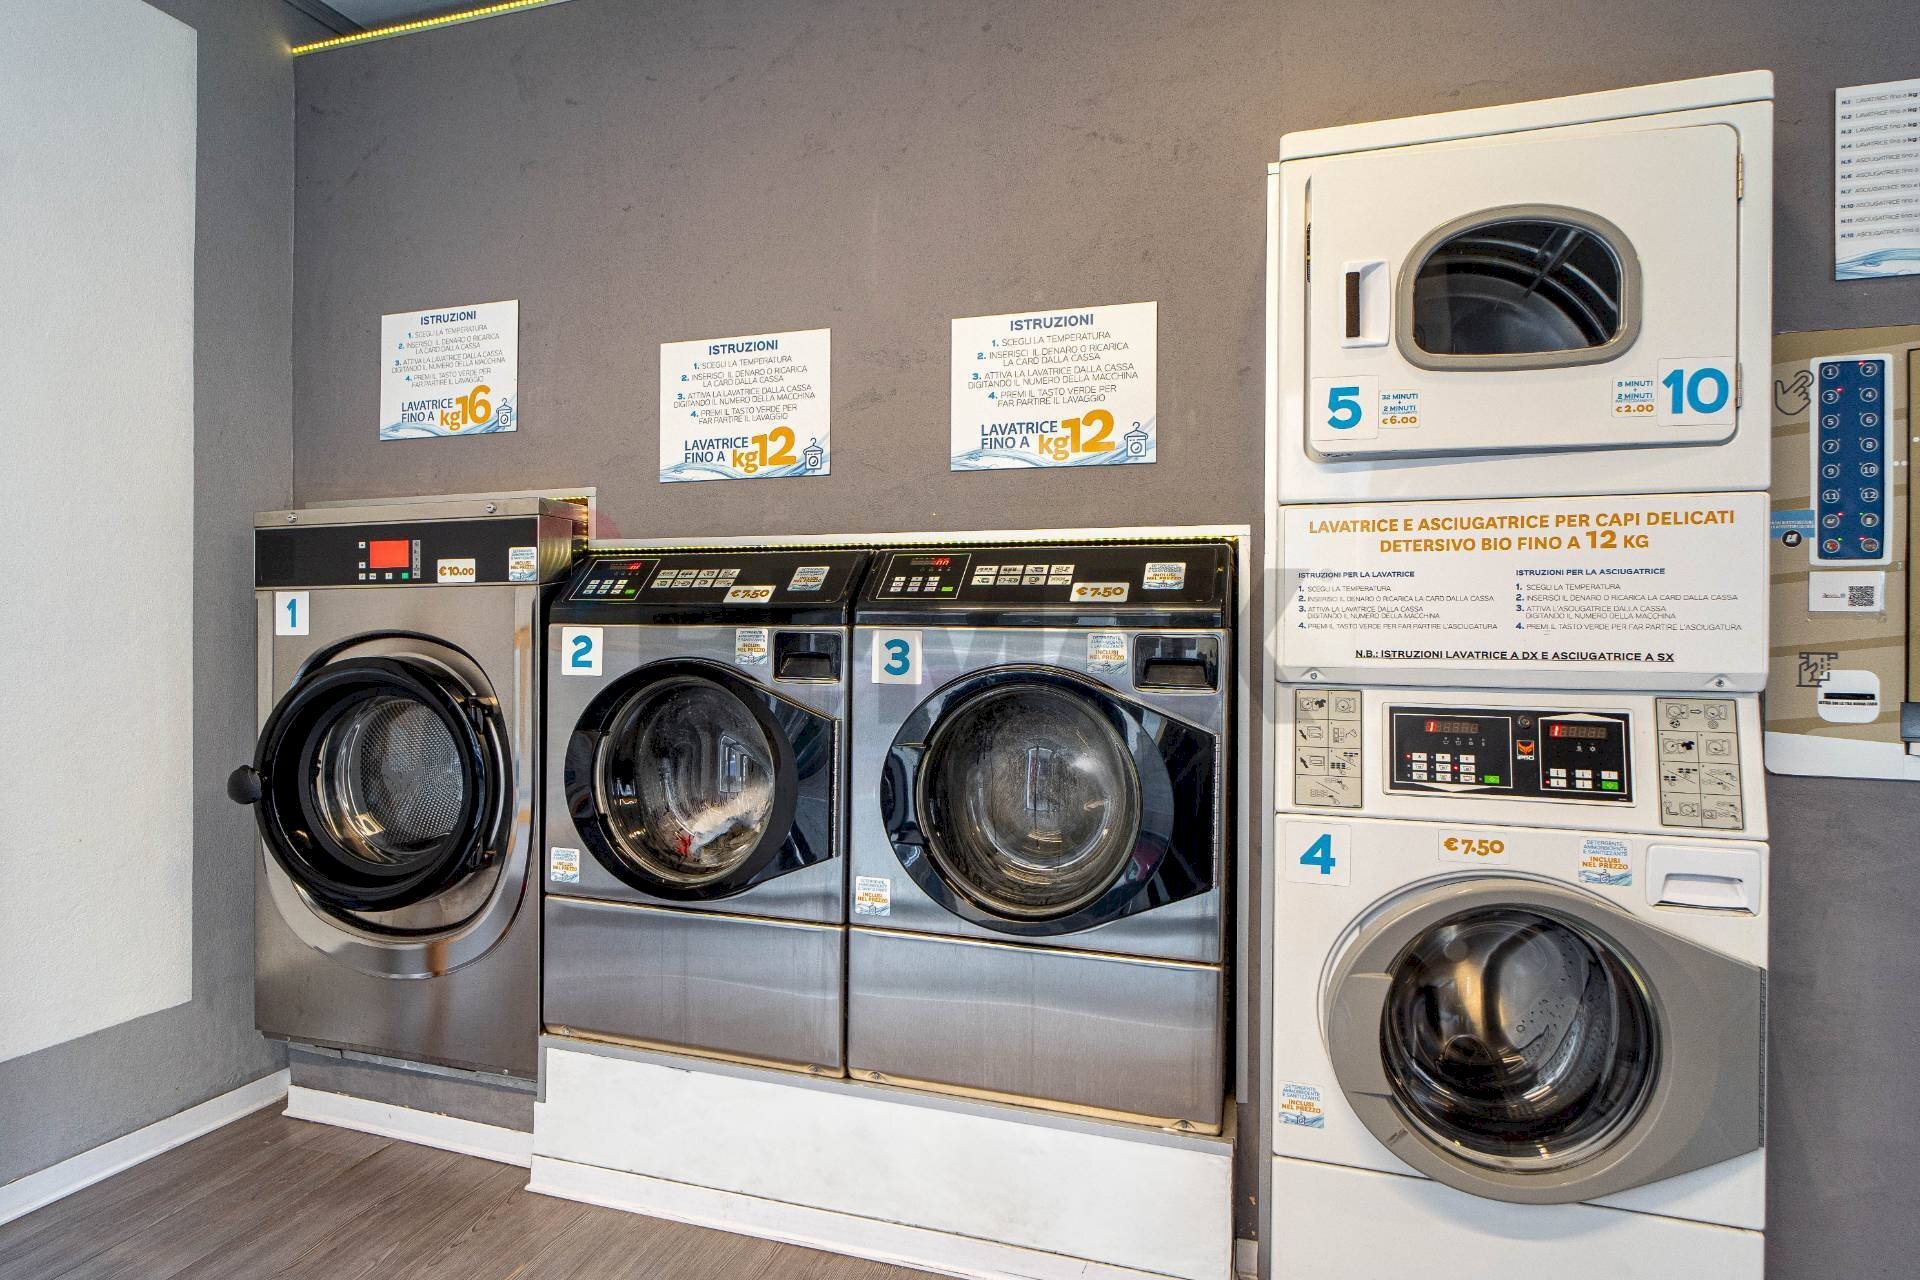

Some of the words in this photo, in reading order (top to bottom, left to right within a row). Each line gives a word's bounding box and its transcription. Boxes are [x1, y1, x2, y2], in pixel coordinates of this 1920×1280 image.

[420, 311, 476, 325] ISTRUZIONI
[1010, 314, 1094, 332] ISTRUZIONI
[1002, 338, 1032, 346] SCEGLI
[1034, 336, 1044, 344] LA
[1046, 331, 1110, 342] TEMPERATURA
[708, 340, 778, 356] ISTRUZIONI
[990, 350, 1028, 359] INSERISCI
[1032, 348, 1040, 356] IL
[1042, 346, 1078, 356] DENARO
[1080, 344, 1086, 353] O
[1090, 342, 1128, 352] RICARICA
[702, 360, 726, 370] SCEGLI
[728, 360, 738, 368] LA
[740, 355, 792, 366] TEMPERATURA
[1016, 356, 1040, 366] CARD
[1042, 355, 1069, 364] DALLA
[1070, 352, 1100, 362] CASSA
[692, 371, 725, 380] INSERISCI
[736, 368, 766, 378] DENARO
[774, 365, 808, 374] RICARICA
[972, 372, 982, 380] 3.
[984, 371, 1012, 380] ATTIVA
[1014, 370, 1026, 378] LA
[1028, 366, 1072, 376] LAVATRICE
[1074, 364, 1102, 374] DALLA
[1104, 362, 1134, 372] CASSA
[714, 378, 734, 387] CARD
[734, 376, 758, 385] DALLA
[760, 374, 784, 383] CASSA
[968, 380, 1012, 390] DIGITANDO
[1014, 378, 1020, 386] IL
[1022, 376, 1060, 386] NUMERO
[1062, 374, 1090, 384] DELLA
[1092, 371, 1138, 381] MACCHINA
[688, 391, 711, 400] ATTIVA
[723, 387, 760, 397] LAVATRICE
[762, 386, 786, 394] DALLA
[786, 384, 812, 392] CASSA
[988, 392, 998, 400] 4.
[1000, 390, 1026, 398] PREMI
[1028, 390, 1036, 398] IL
[1038, 388, 1065, 396] TASTO
[1067, 386, 1096, 394] VERDE
[1098, 384, 1117, 392] PER
[1662, 368, 1730, 414] 10
[402, 398, 452, 412] LAVATRICE
[998, 400, 1014, 408] FAR
[1016, 396, 1052, 406] PARTIRE
[1054, 396, 1060, 404] IL
[1062, 394, 1106, 404] LAVAGGIO
[1327, 386, 1362, 429] 5
[402, 412, 425, 423] FINO
[428, 411, 434, 422] A
[981, 420, 1058, 436] LAVATRICE
[684, 436, 748, 451] LAVATRICE
[982, 436, 1016, 450] FINO
[1020, 436, 1030, 448] A
[684, 452, 714, 464] FINO
[716, 451, 725, 462] A
[1309, 519, 1398, 534] LAVATRICE
[1404, 518, 1413, 532] E
[1418, 514, 1550, 531] ASCIUGATRICE
[1555, 514, 1590, 528] PER
[1596, 512, 1640, 526] CAPI
[1646, 510, 1735, 526] DELICATI
[1380, 538, 1476, 552] DETERSIVO
[1482, 537, 1512, 550] BIO
[1518, 536, 1562, 550] FINO
[1567, 536, 1580, 549] A
[1586, 530, 1617, 548] 12
[1624, 534, 1648, 548] KG
[286, 598, 296, 628] 1
[572, 635, 593, 668] 2
[883, 638, 910, 676] 3
[1381, 650, 1442, 658] ISTRUZIONI
[1552, 652, 1641, 660] ASCIUGATRICE
[1300, 834, 1336, 875] 4
